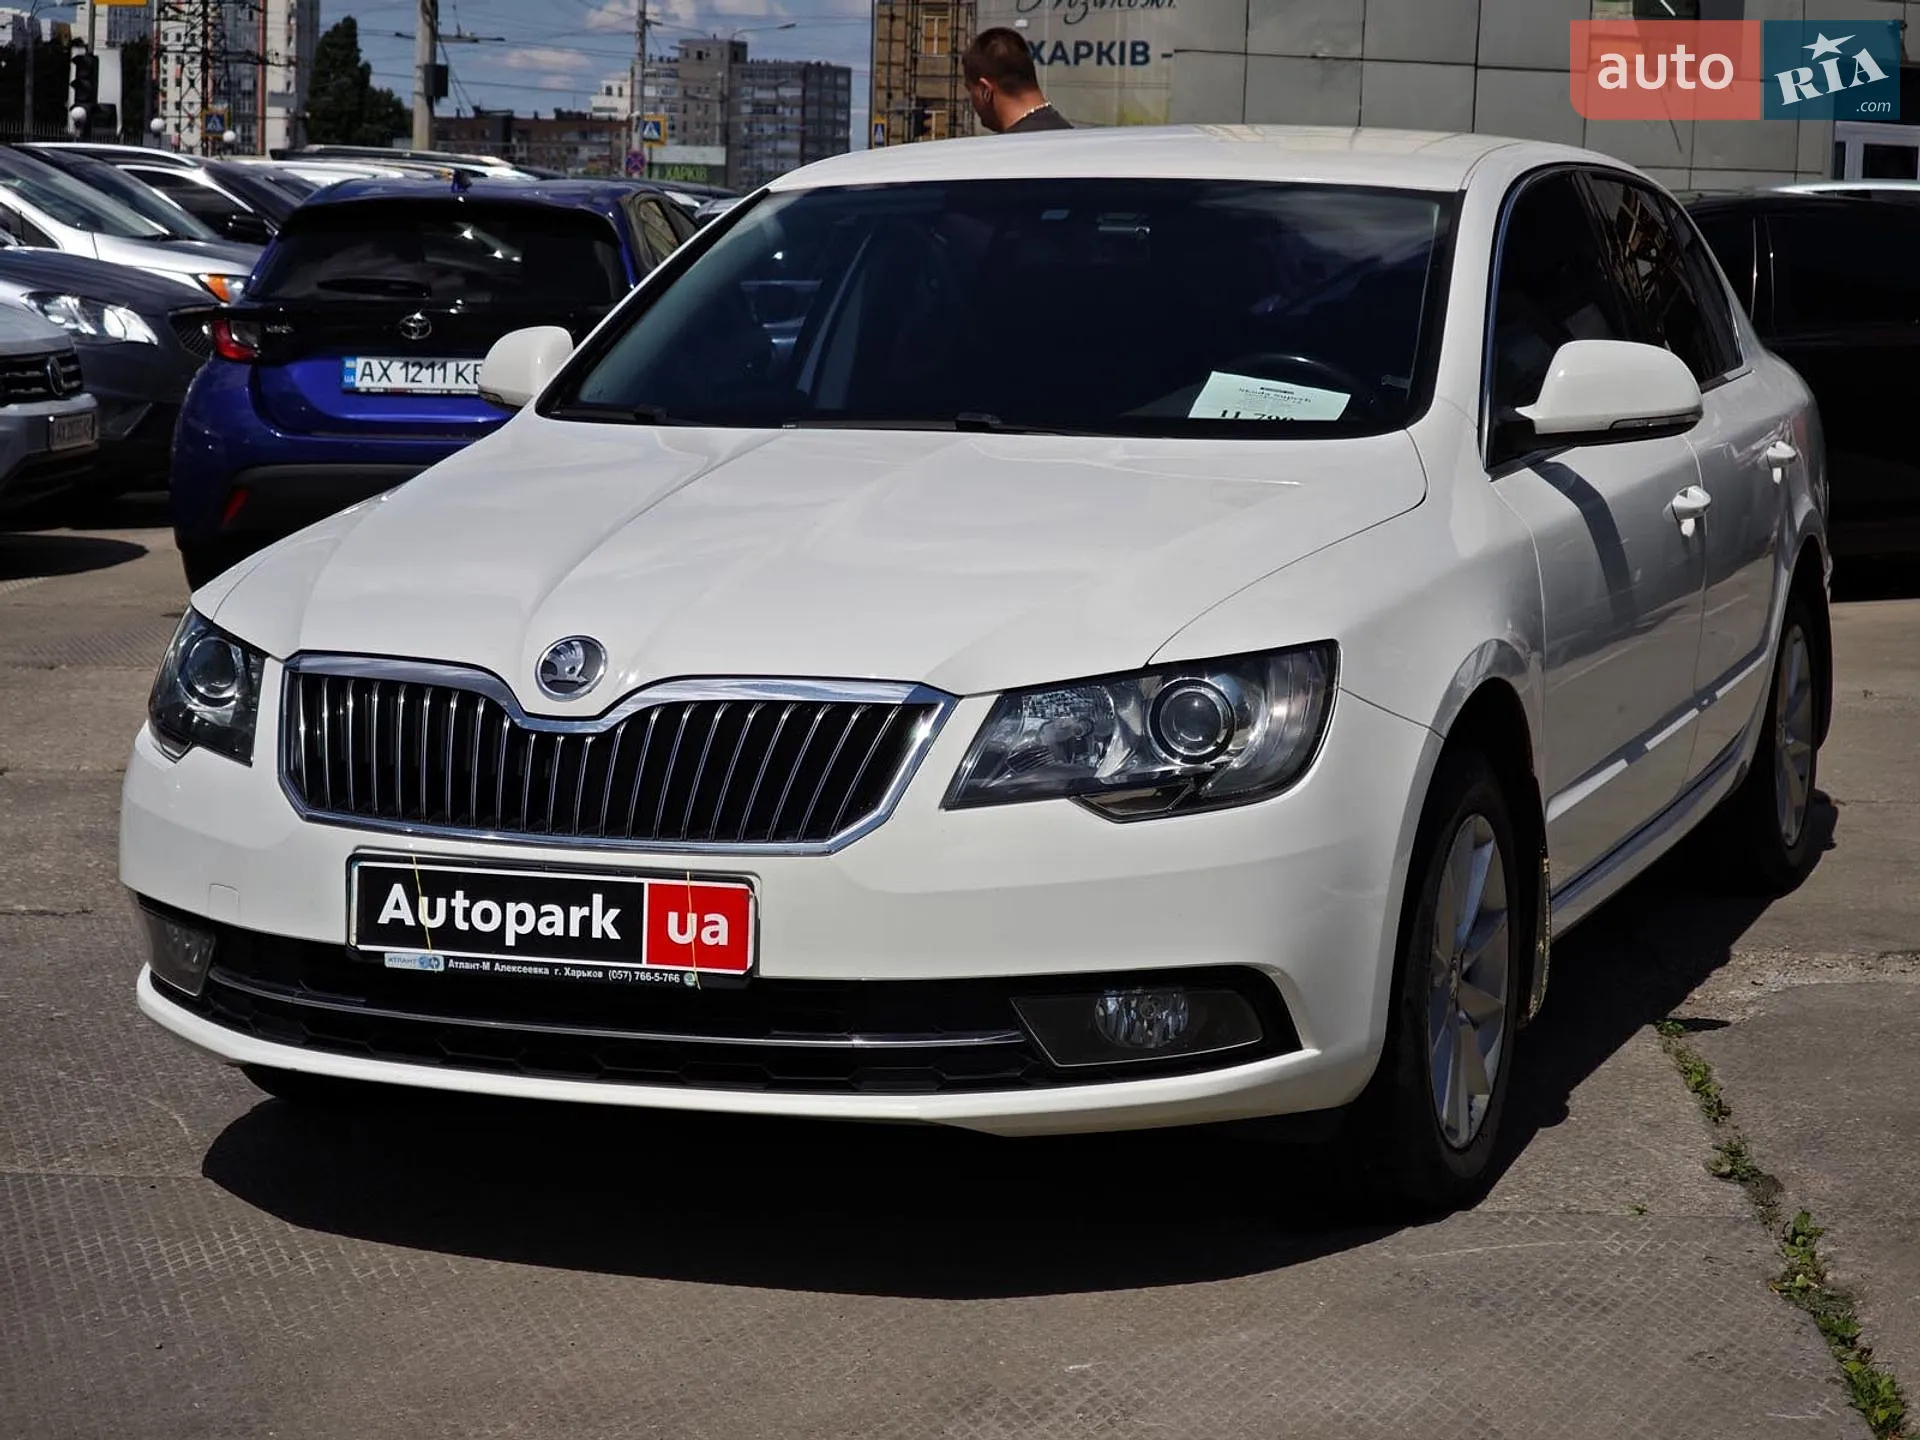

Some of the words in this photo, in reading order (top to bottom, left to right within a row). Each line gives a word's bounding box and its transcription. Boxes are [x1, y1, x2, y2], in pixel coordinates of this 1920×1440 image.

[1027, 40, 1150, 66] ХАРКІВ
[359, 361, 393, 382] AX
[399, 361, 447, 383] 1211
[377, 882, 622, 947] Autopark
[666, 910, 729, 946] ua
[448, 958, 490, 971] Атлант-М
[494, 962, 549, 975] Алексеевка
[564, 967, 604, 979] Харьков
[608, 969, 632, 982] (057)
[635, 971, 680, 984] 766-5-766
